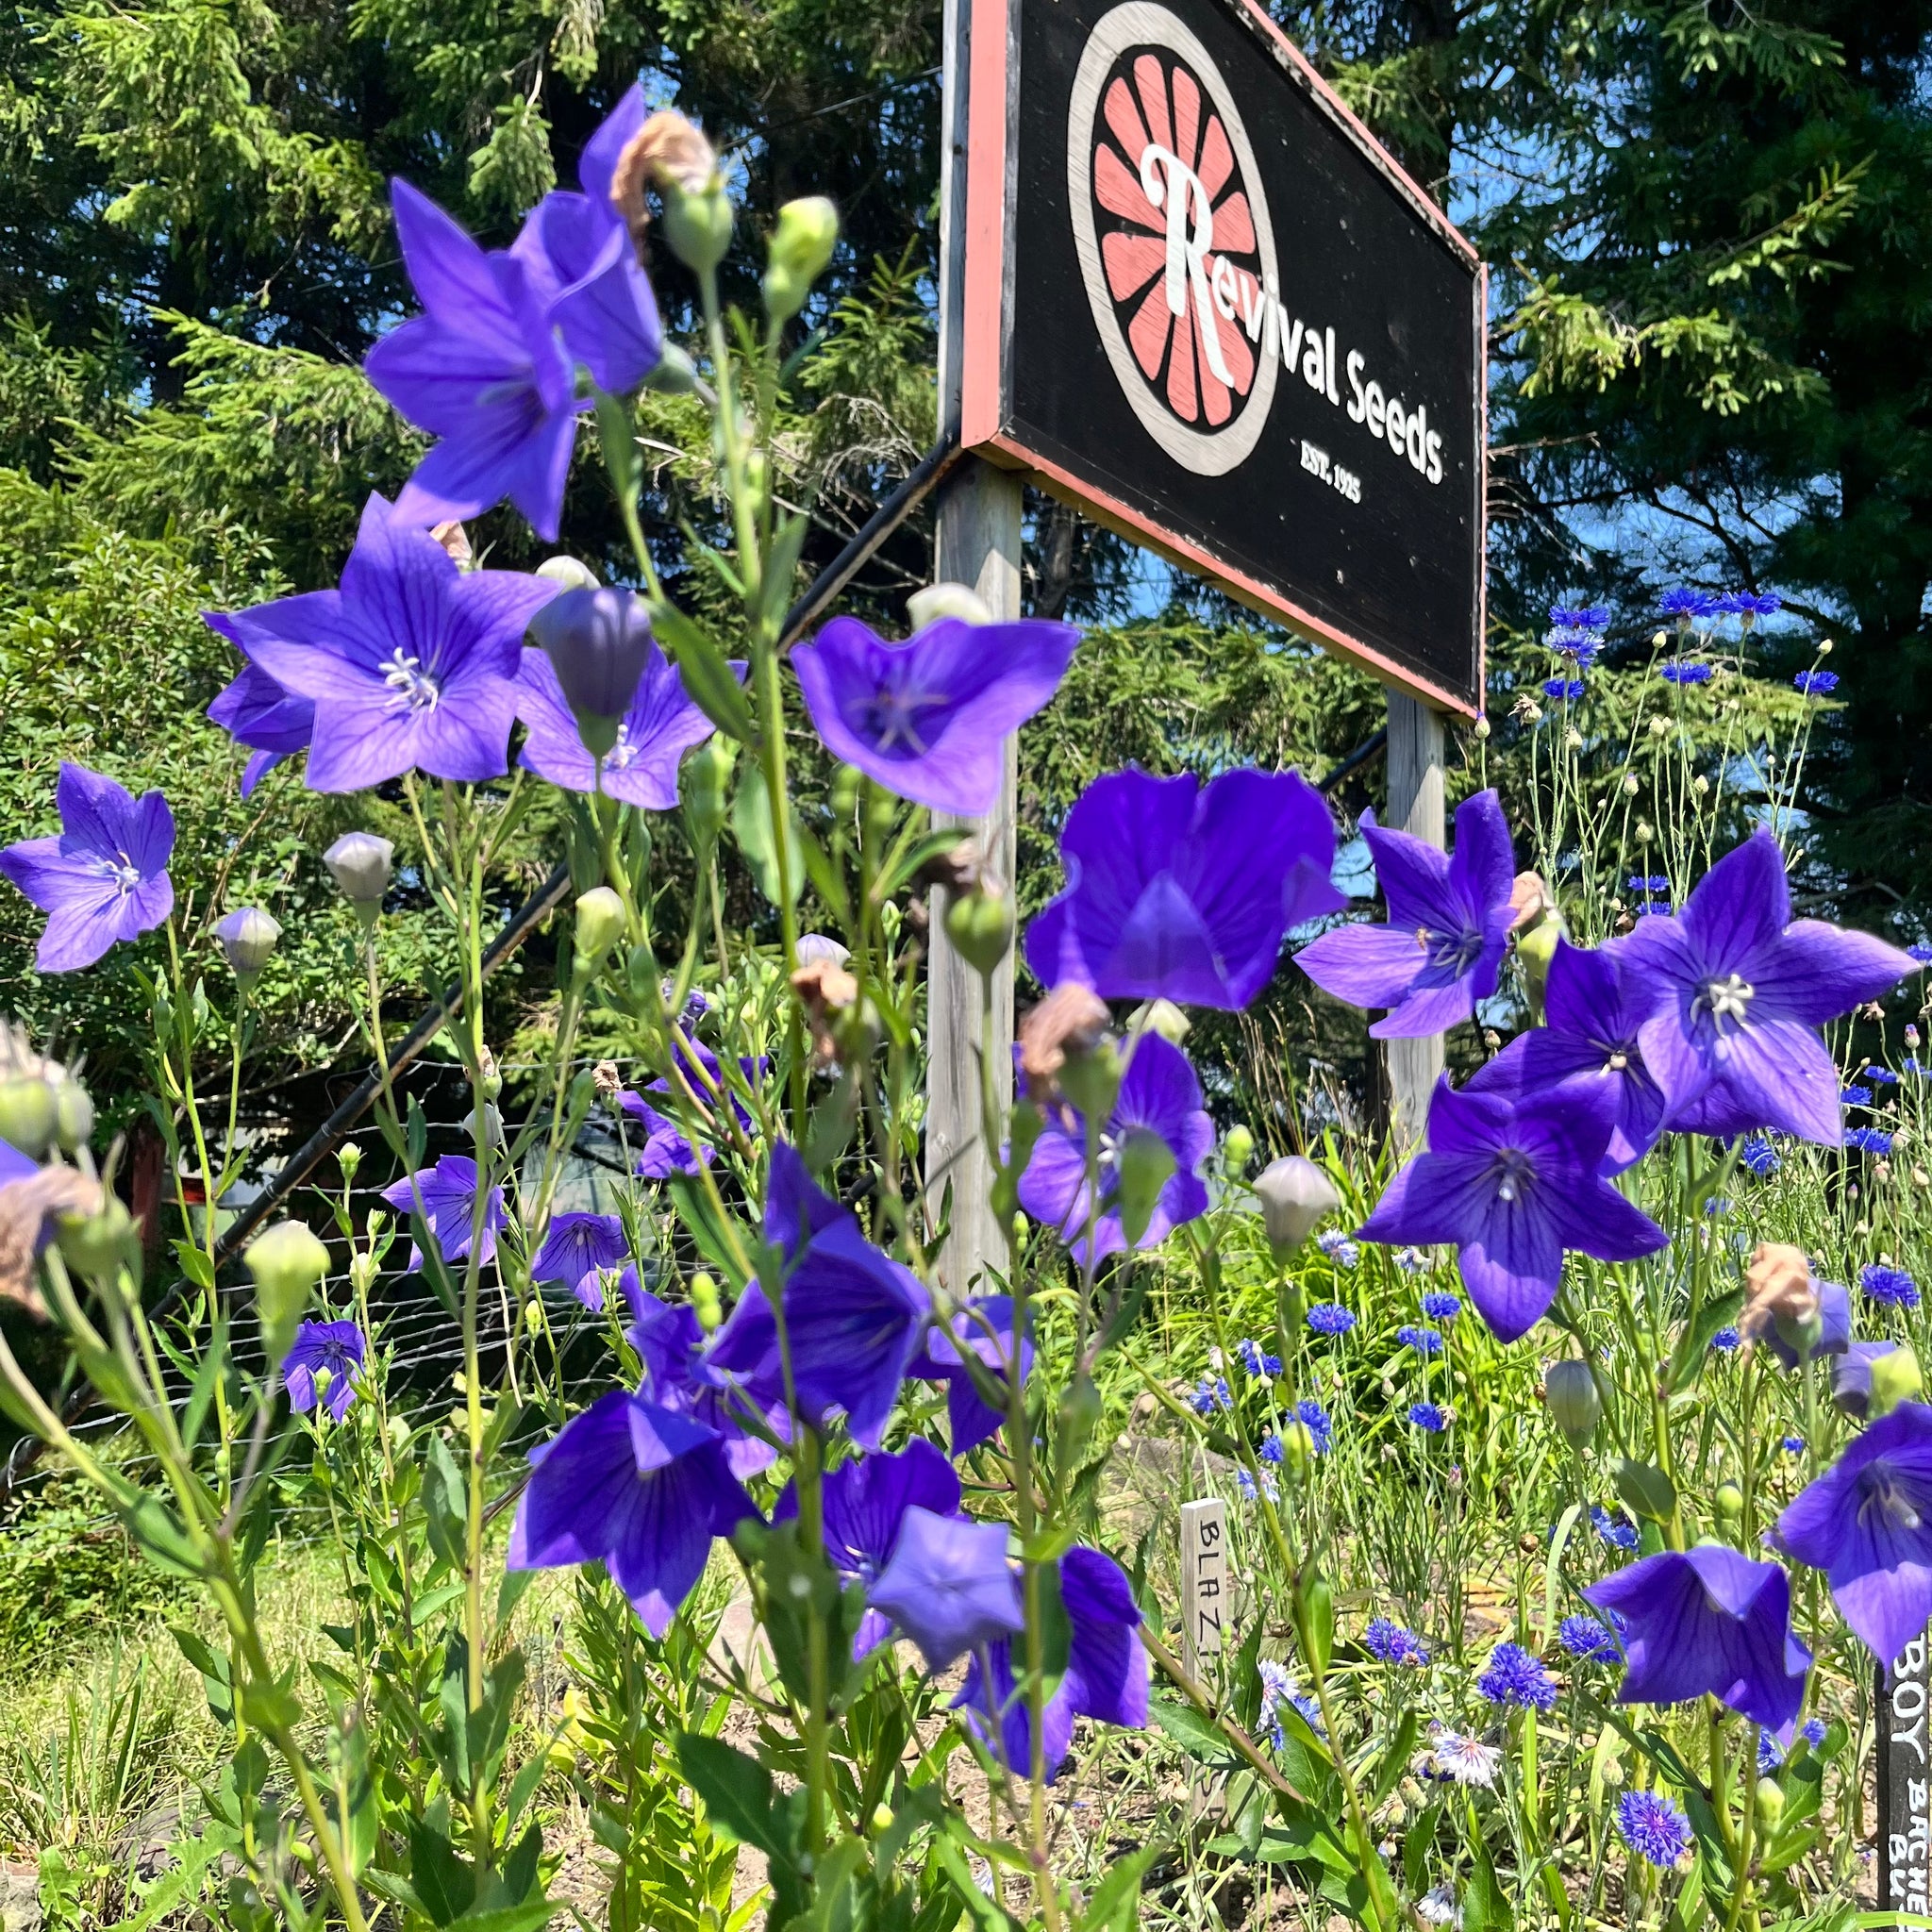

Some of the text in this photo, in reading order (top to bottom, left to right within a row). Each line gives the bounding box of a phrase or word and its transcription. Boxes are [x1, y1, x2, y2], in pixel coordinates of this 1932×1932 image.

[1140, 143, 1443, 485] Revival Seeds
[1300, 439, 1333, 486] EST.
[1890, 1631, 1925, 1765] BOY
